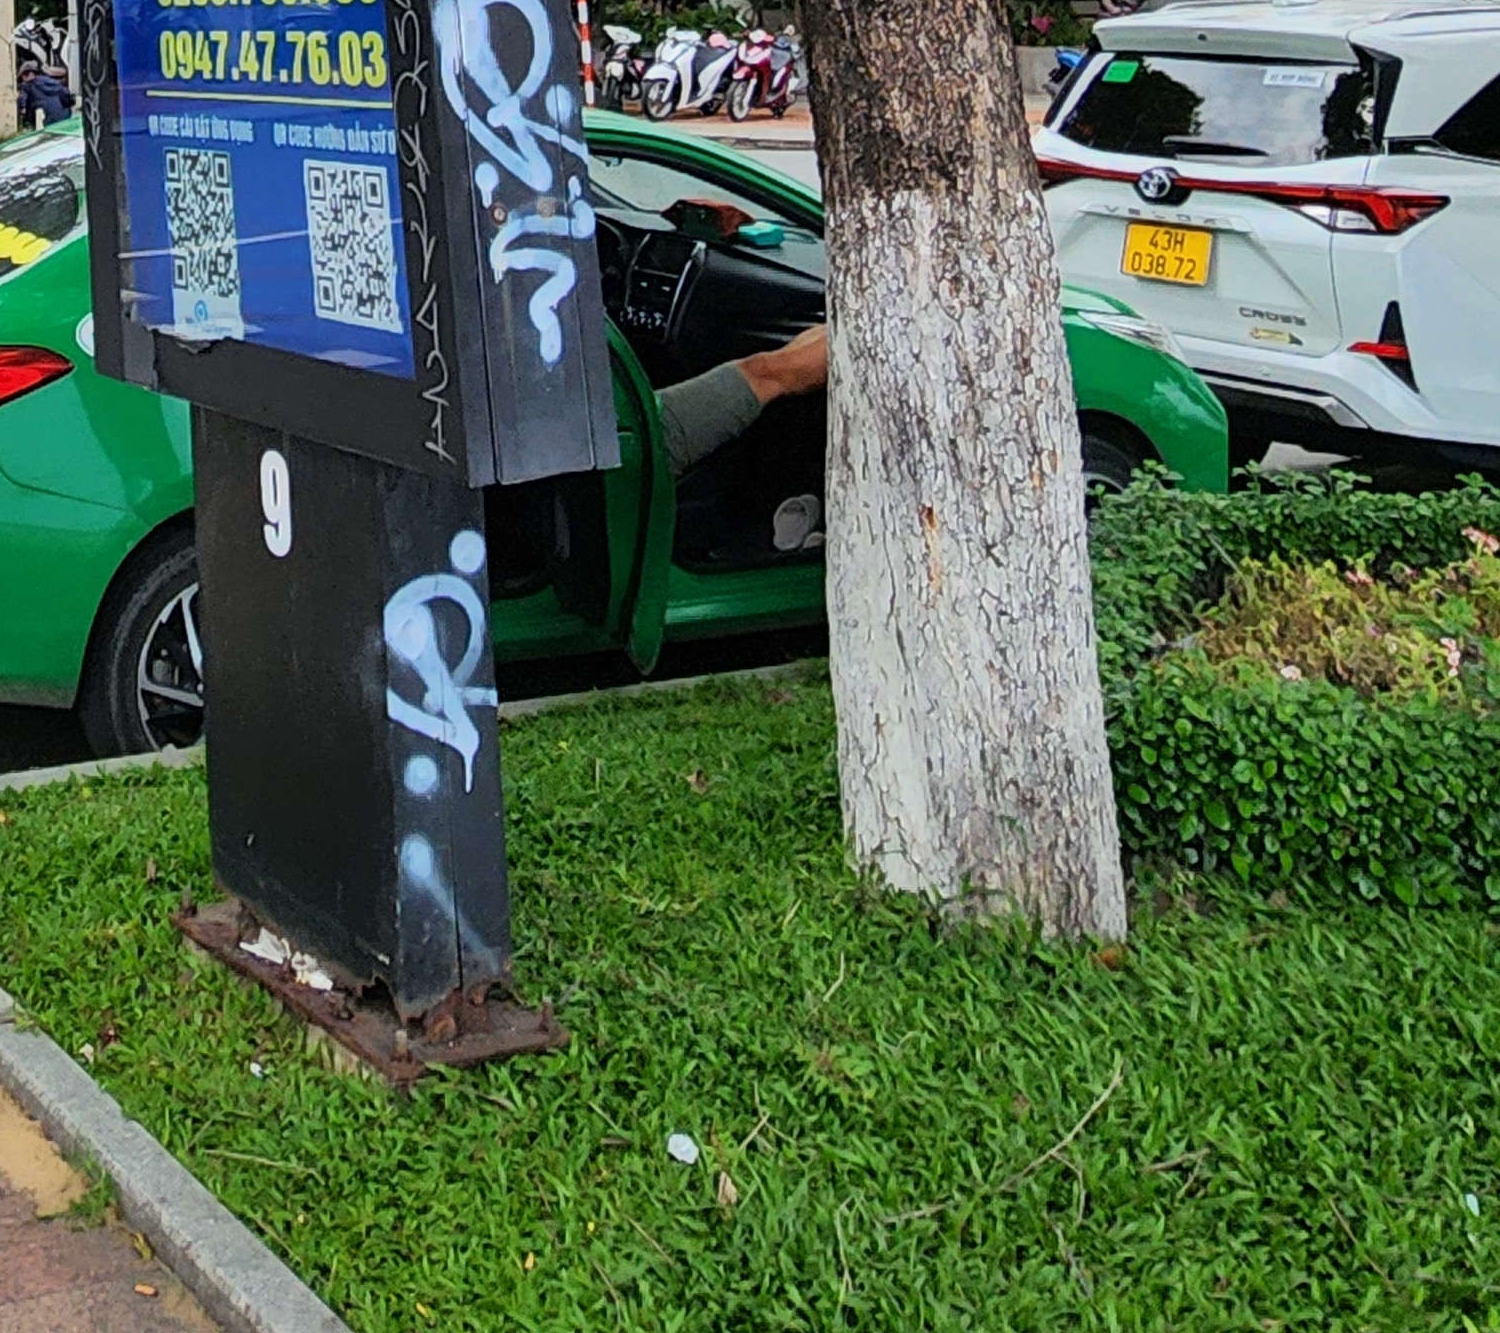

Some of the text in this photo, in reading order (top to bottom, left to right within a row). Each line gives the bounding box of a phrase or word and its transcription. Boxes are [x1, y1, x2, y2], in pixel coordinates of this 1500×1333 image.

[160, 30, 388, 88] 0947.47.76.03
[1149, 229, 1185, 254] 43H
[1131, 251, 1197, 280] 038.72
[260, 450, 292, 558] 9
